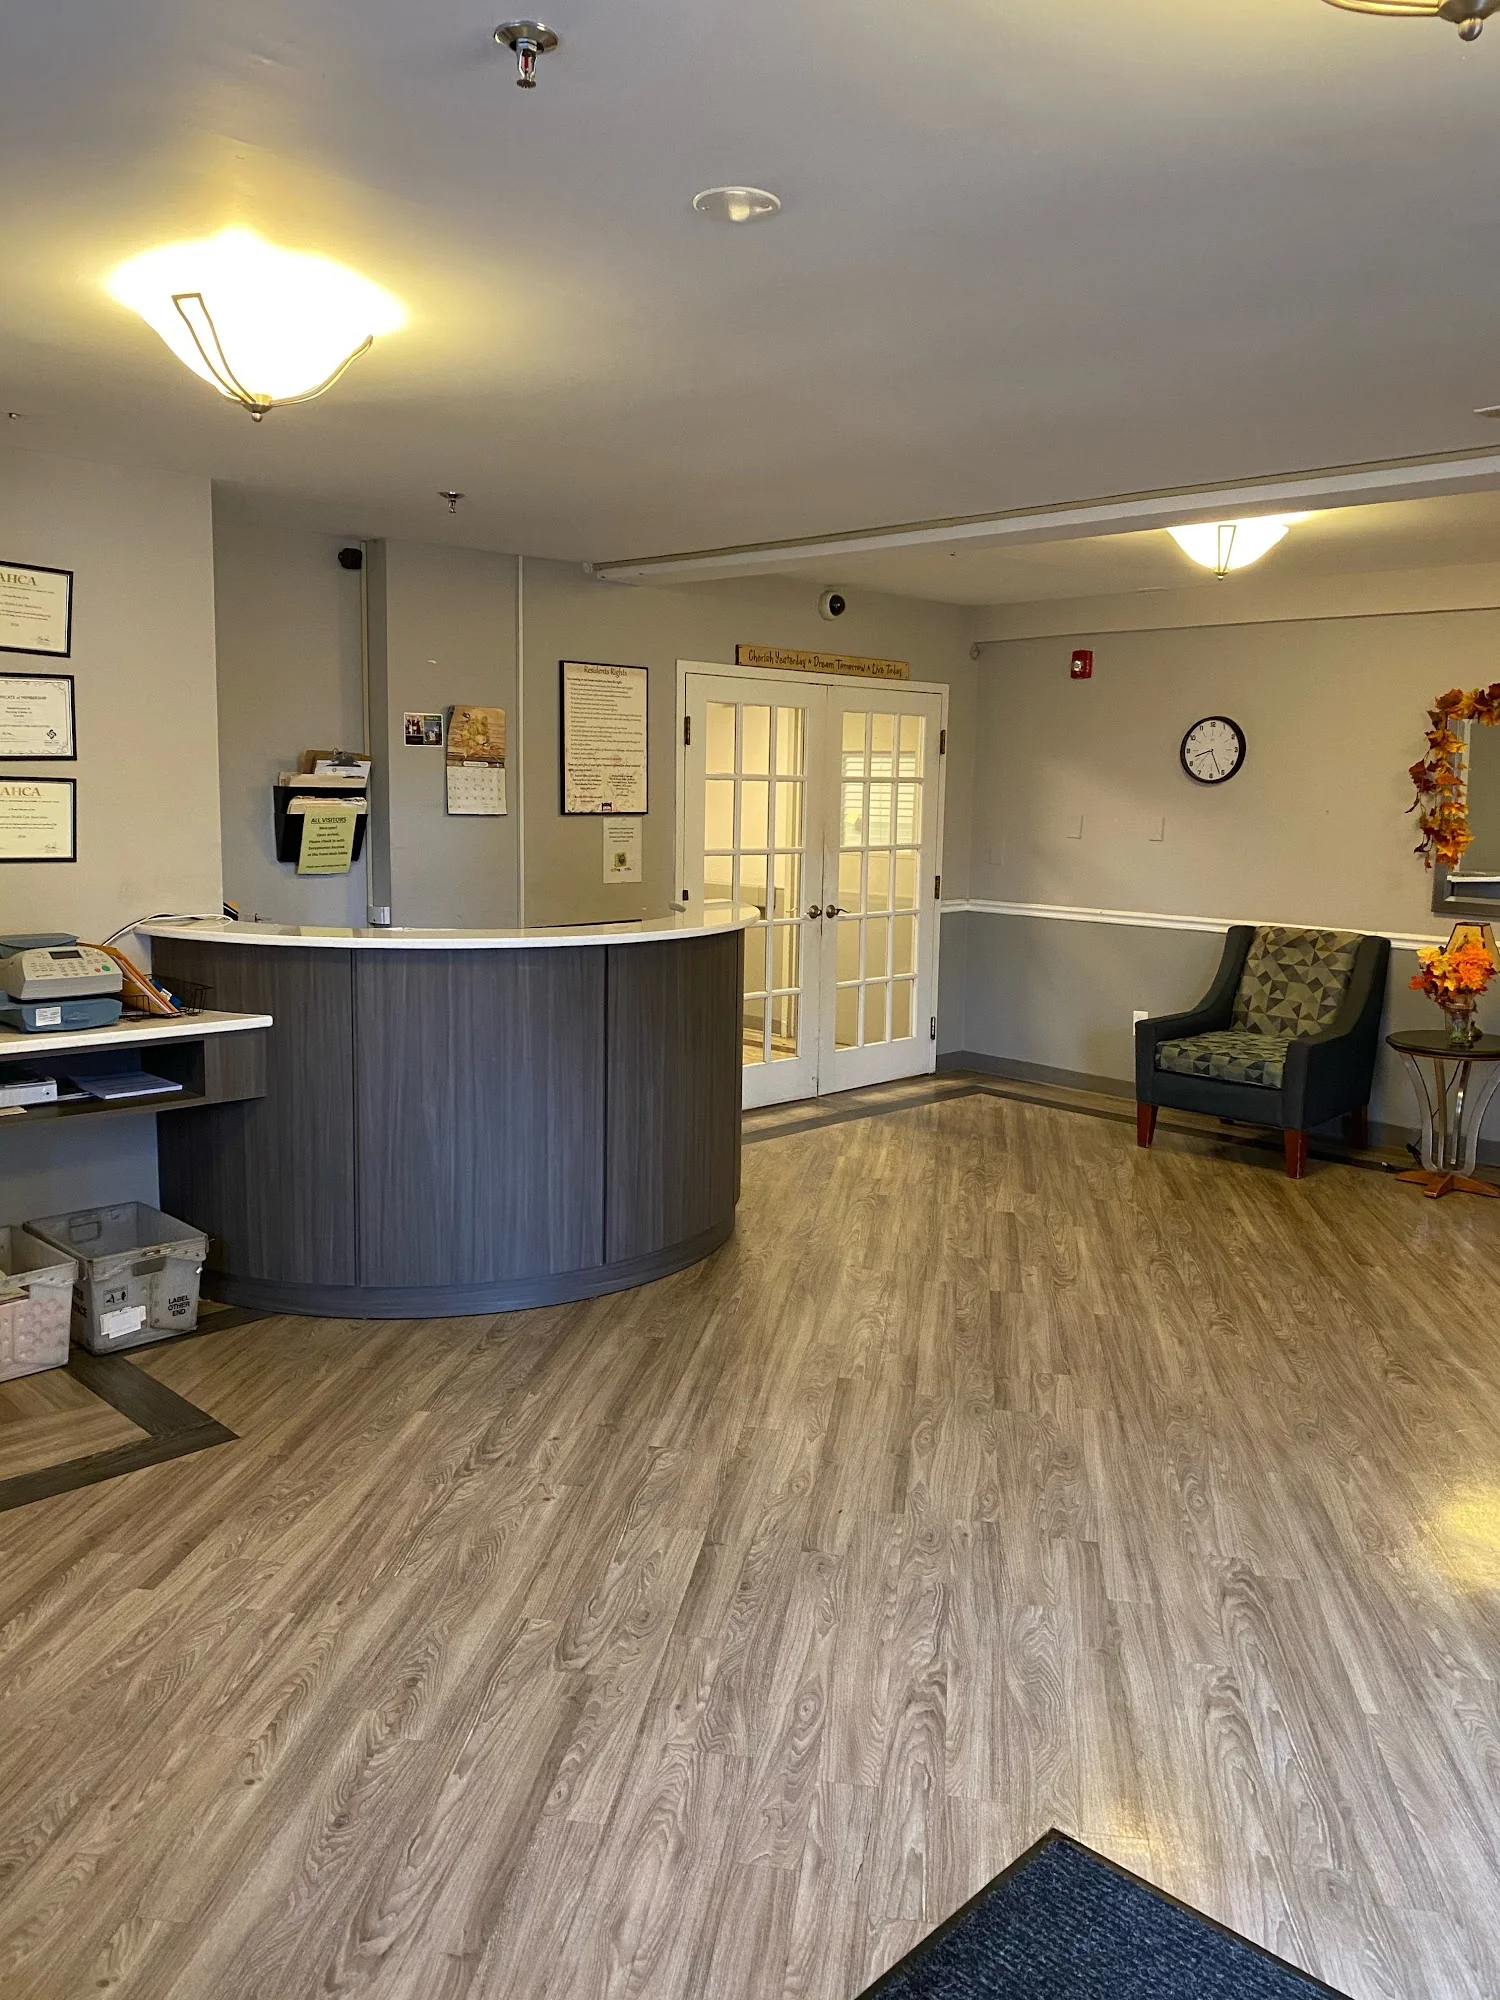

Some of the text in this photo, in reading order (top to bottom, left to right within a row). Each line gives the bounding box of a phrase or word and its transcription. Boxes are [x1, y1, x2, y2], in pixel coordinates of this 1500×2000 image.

[748, 649, 902, 678] Cherish Yesterday Dream Tomorrow Live Today
[584, 666, 627, 678] Residents Rights
[0, 787, 42, 797] AHCA
[168, 1295, 190, 1305] LABEL
[168, 1300, 190, 1311] OTHER
[172, 1308, 186, 1316] END
